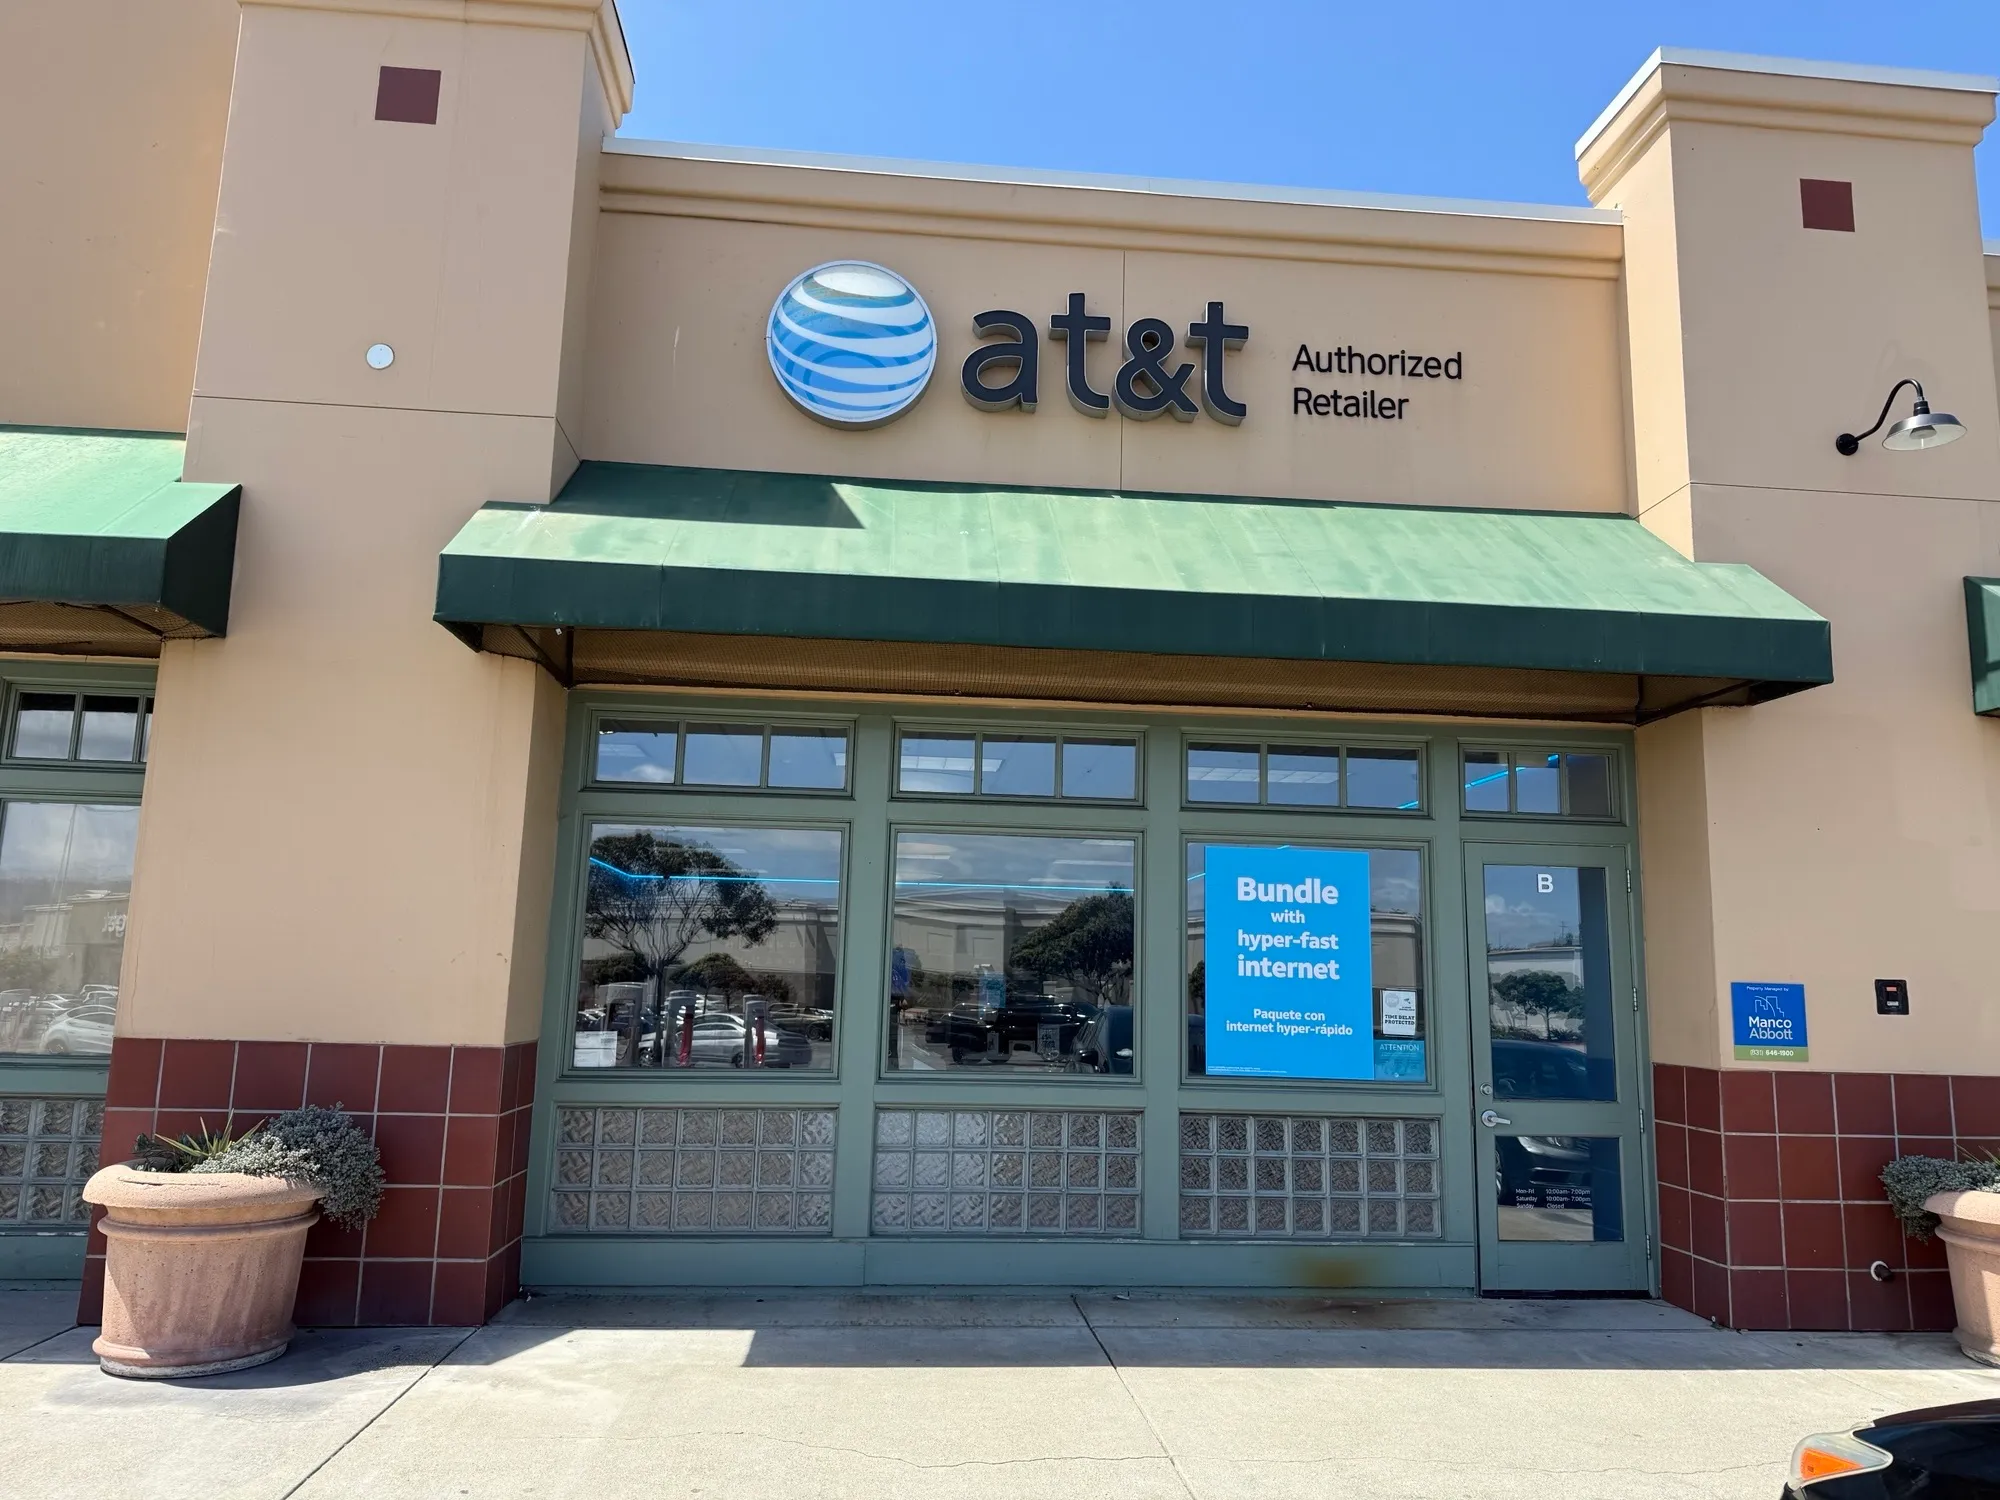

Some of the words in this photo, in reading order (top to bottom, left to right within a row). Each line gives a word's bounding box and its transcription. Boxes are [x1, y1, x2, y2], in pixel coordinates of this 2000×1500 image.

[961, 293, 1249, 427] at&t
[1292, 344, 1462, 380] Authorized
[1293, 387, 1410, 420] Retailer
[1237, 877, 1339, 905] Bundle
[1537, 873, 1554, 893] B
[1270, 909, 1306, 924] with
[1237, 929, 1340, 952] hyper-fast
[1237, 954, 1341, 980] internet
[1253, 1008, 1302, 1022] Paquete
[1304, 1012, 1326, 1021] con
[1748, 1016, 1793, 1029] Manco
[1226, 1020, 1274, 1033] internet
[1276, 1022, 1353, 1037] hyper-rápido
[1749, 1027, 1794, 1040] Abbott
[1379, 1043, 1420, 1052] ATTENTION
